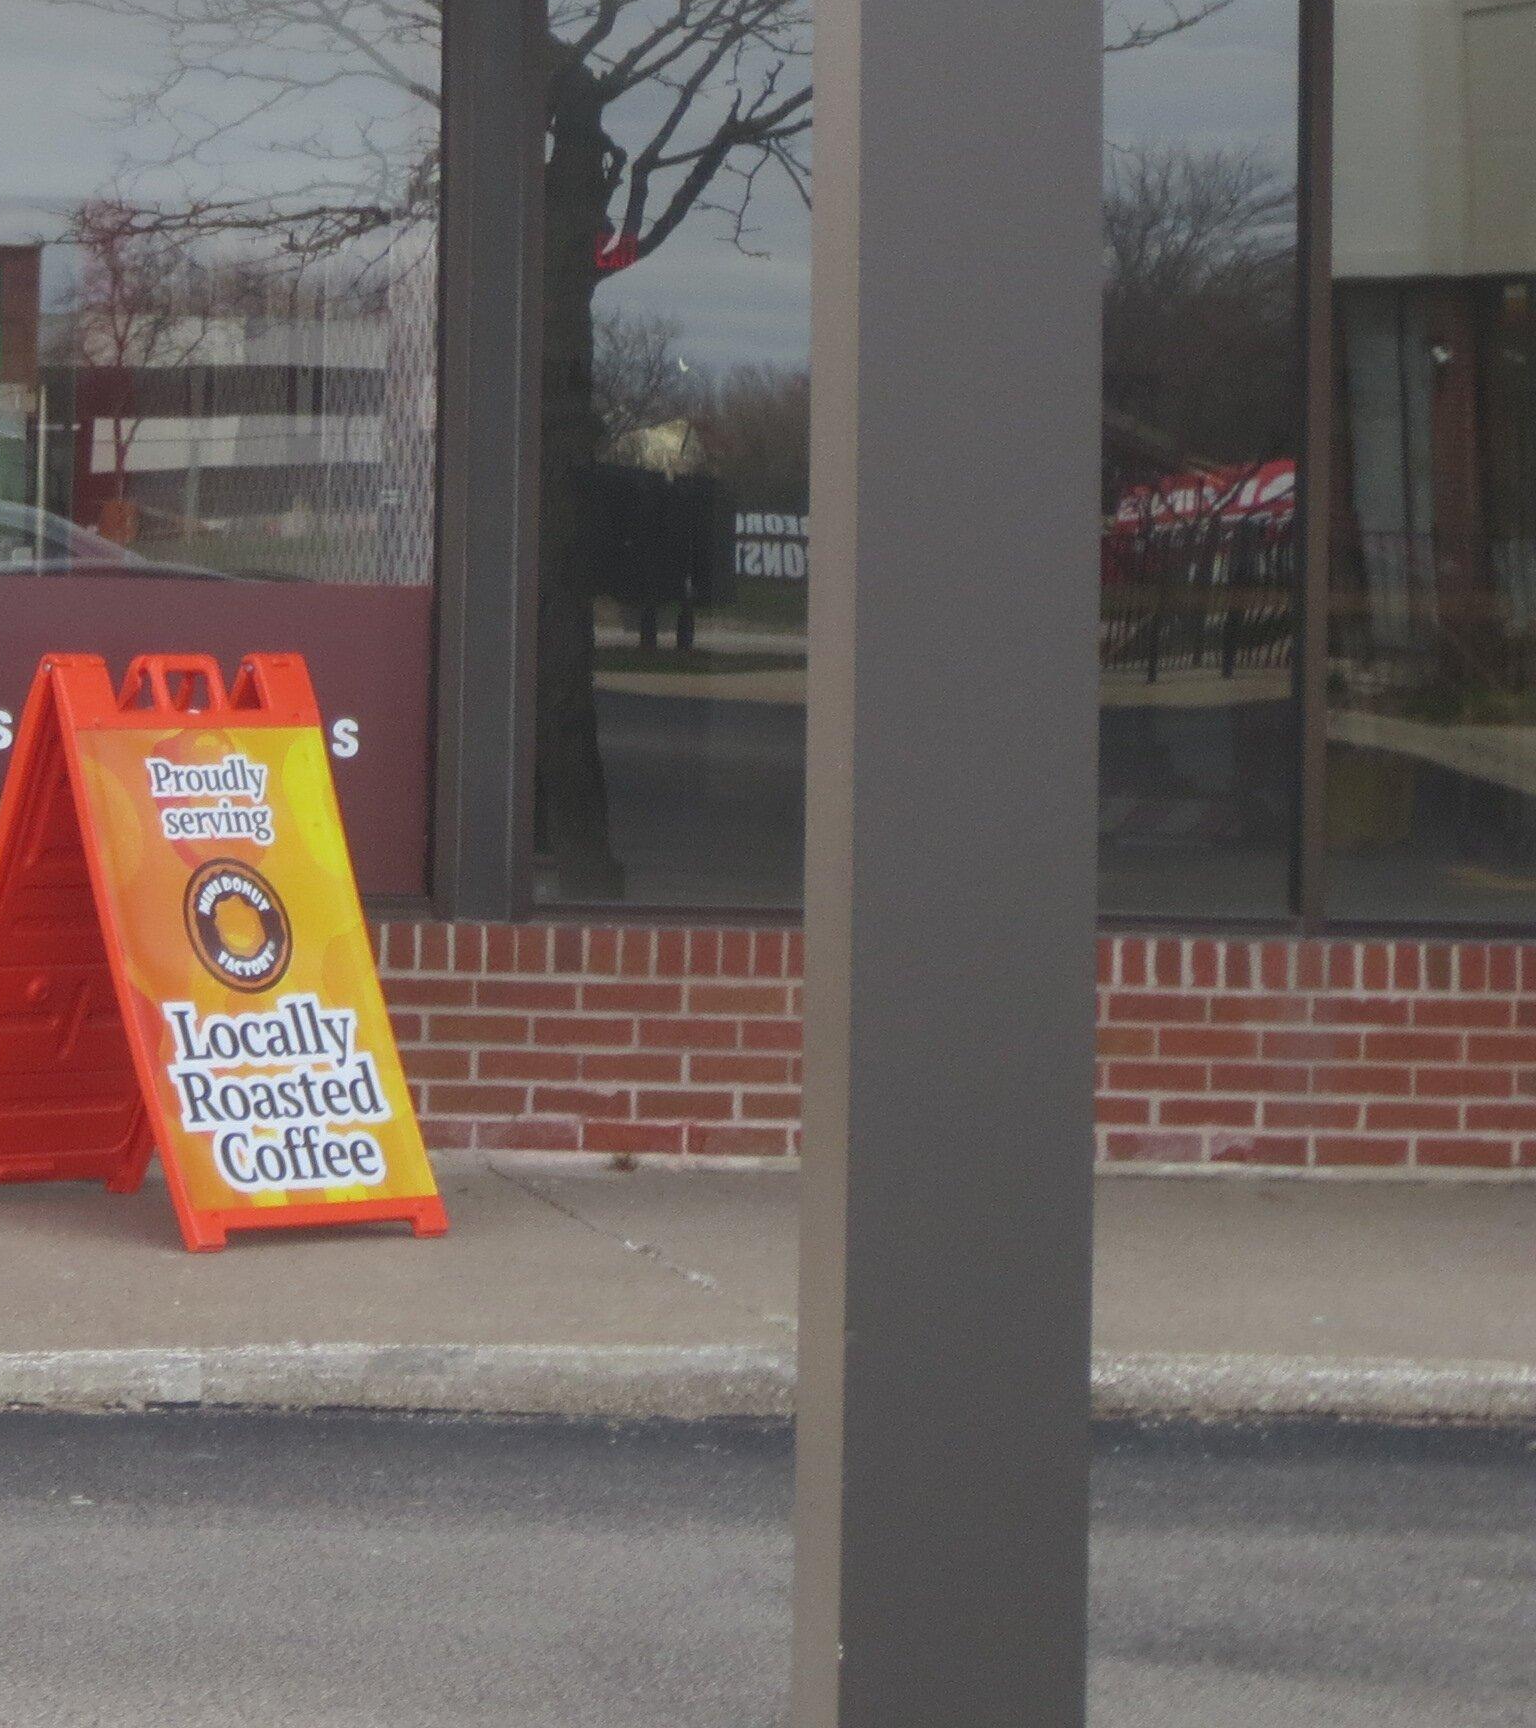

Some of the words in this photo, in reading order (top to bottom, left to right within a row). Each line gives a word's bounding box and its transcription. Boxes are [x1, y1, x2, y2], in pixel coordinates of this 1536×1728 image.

[150, 758, 265, 799] Proudly
[164, 802, 272, 842] serving
[197, 877, 222, 916] MINI
[220, 875, 271, 912] DONUT
[216, 948, 276, 977] FACTORY
[171, 1001, 350, 1068] Locally
[178, 1060, 384, 1123] Roasted
[219, 1124, 379, 1184] Coffee
